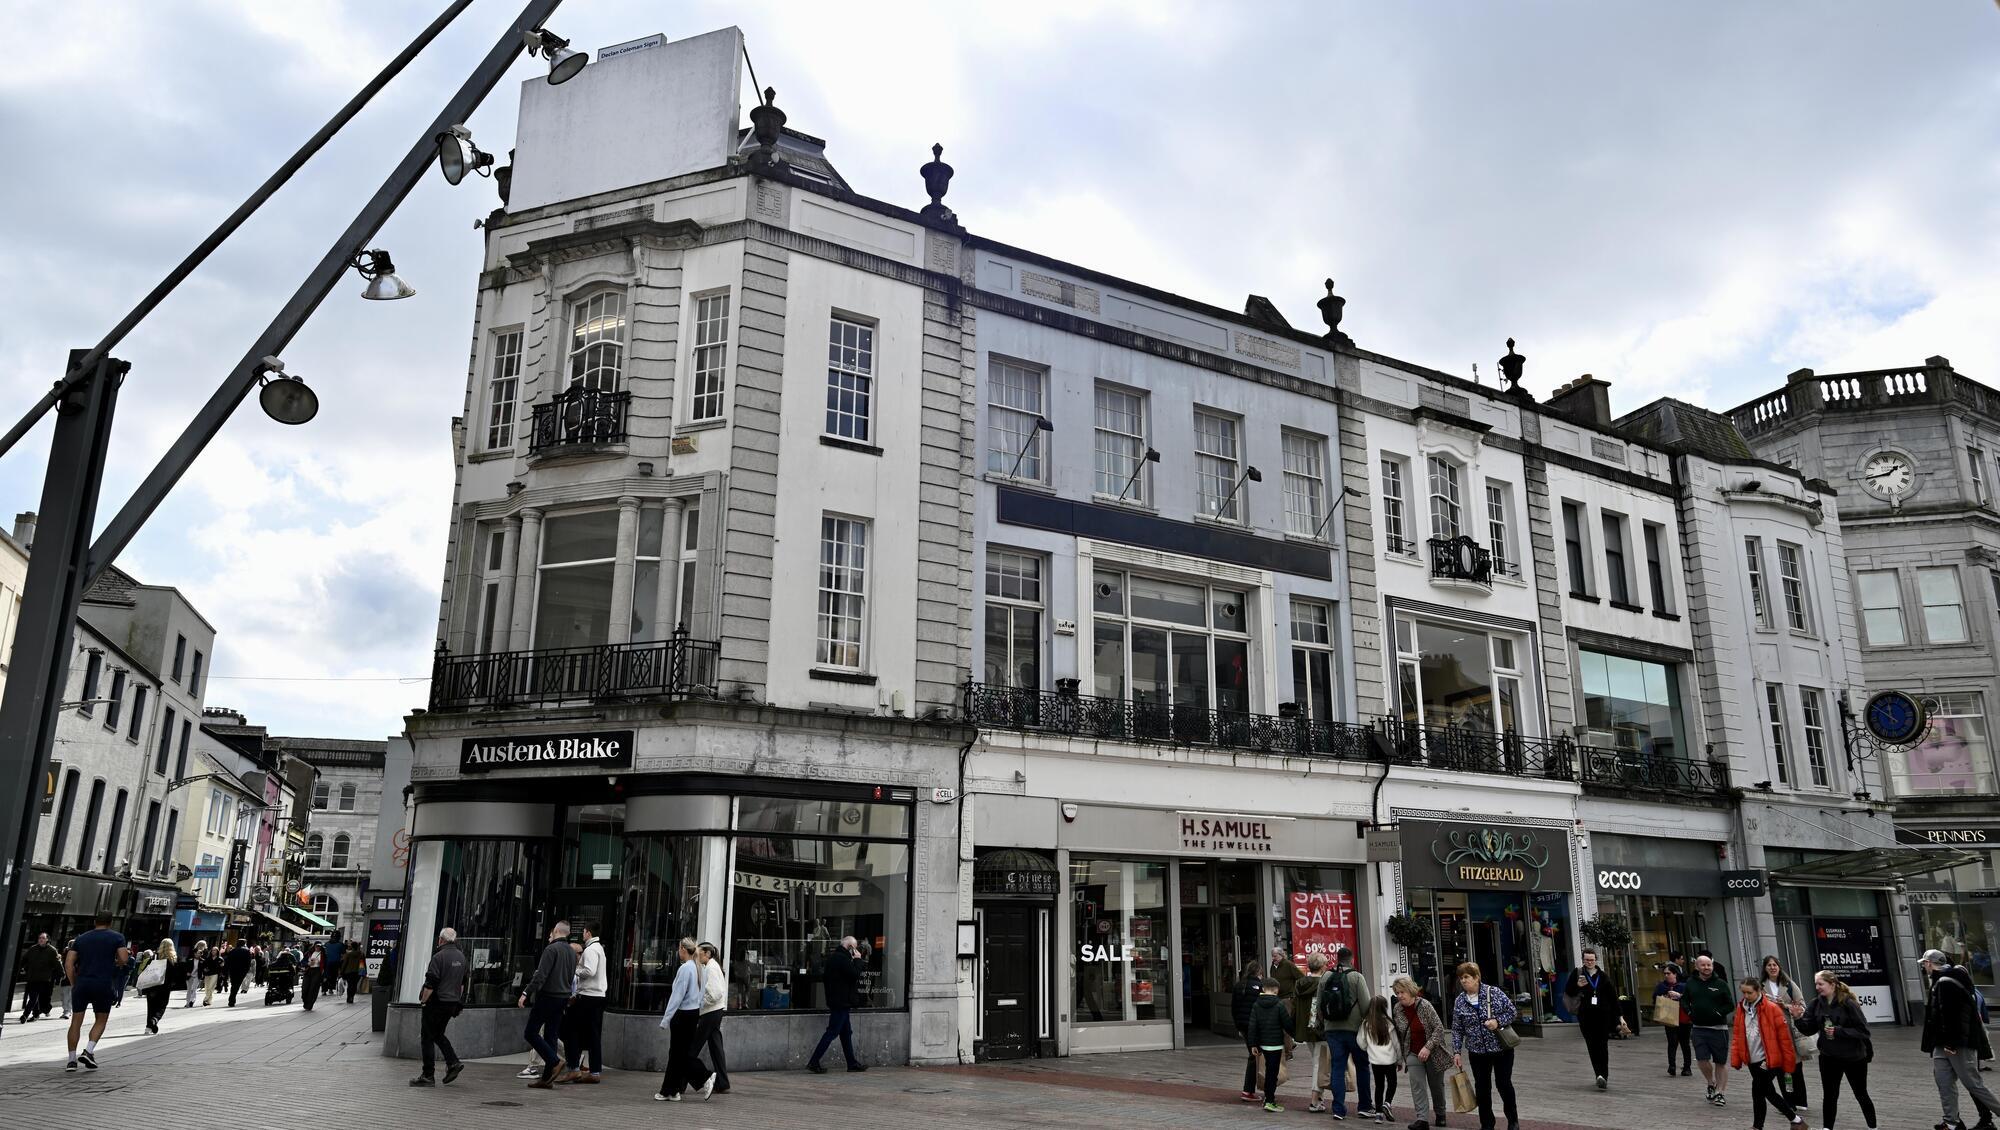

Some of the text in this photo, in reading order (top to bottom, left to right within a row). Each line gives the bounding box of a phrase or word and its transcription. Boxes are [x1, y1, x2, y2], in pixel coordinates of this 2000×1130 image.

[601, 41, 658, 59] Declan Coleman Signs
[1182, 818, 1272, 840] H.SAMUEL
[1746, 817, 1759, 830] 26
[1927, 830, 1987, 843] PENNEYS
[1183, 839, 1272, 852] THE JEWELLER
[229, 844, 243, 894] TATTOO
[1460, 866, 1524, 882] FITZGERALD
[1007, 872, 1052, 883] Chinese
[1598, 870, 1642, 890] ecco
[1727, 878, 1760, 889] ecco
[1295, 907, 1353, 929] SALE
[371, 939, 389, 947] FOR
[1305, 942, 1327, 953] 60%
[1081, 944, 1135, 962] SALE
[1820, 952, 1862, 965] FOR SALE
